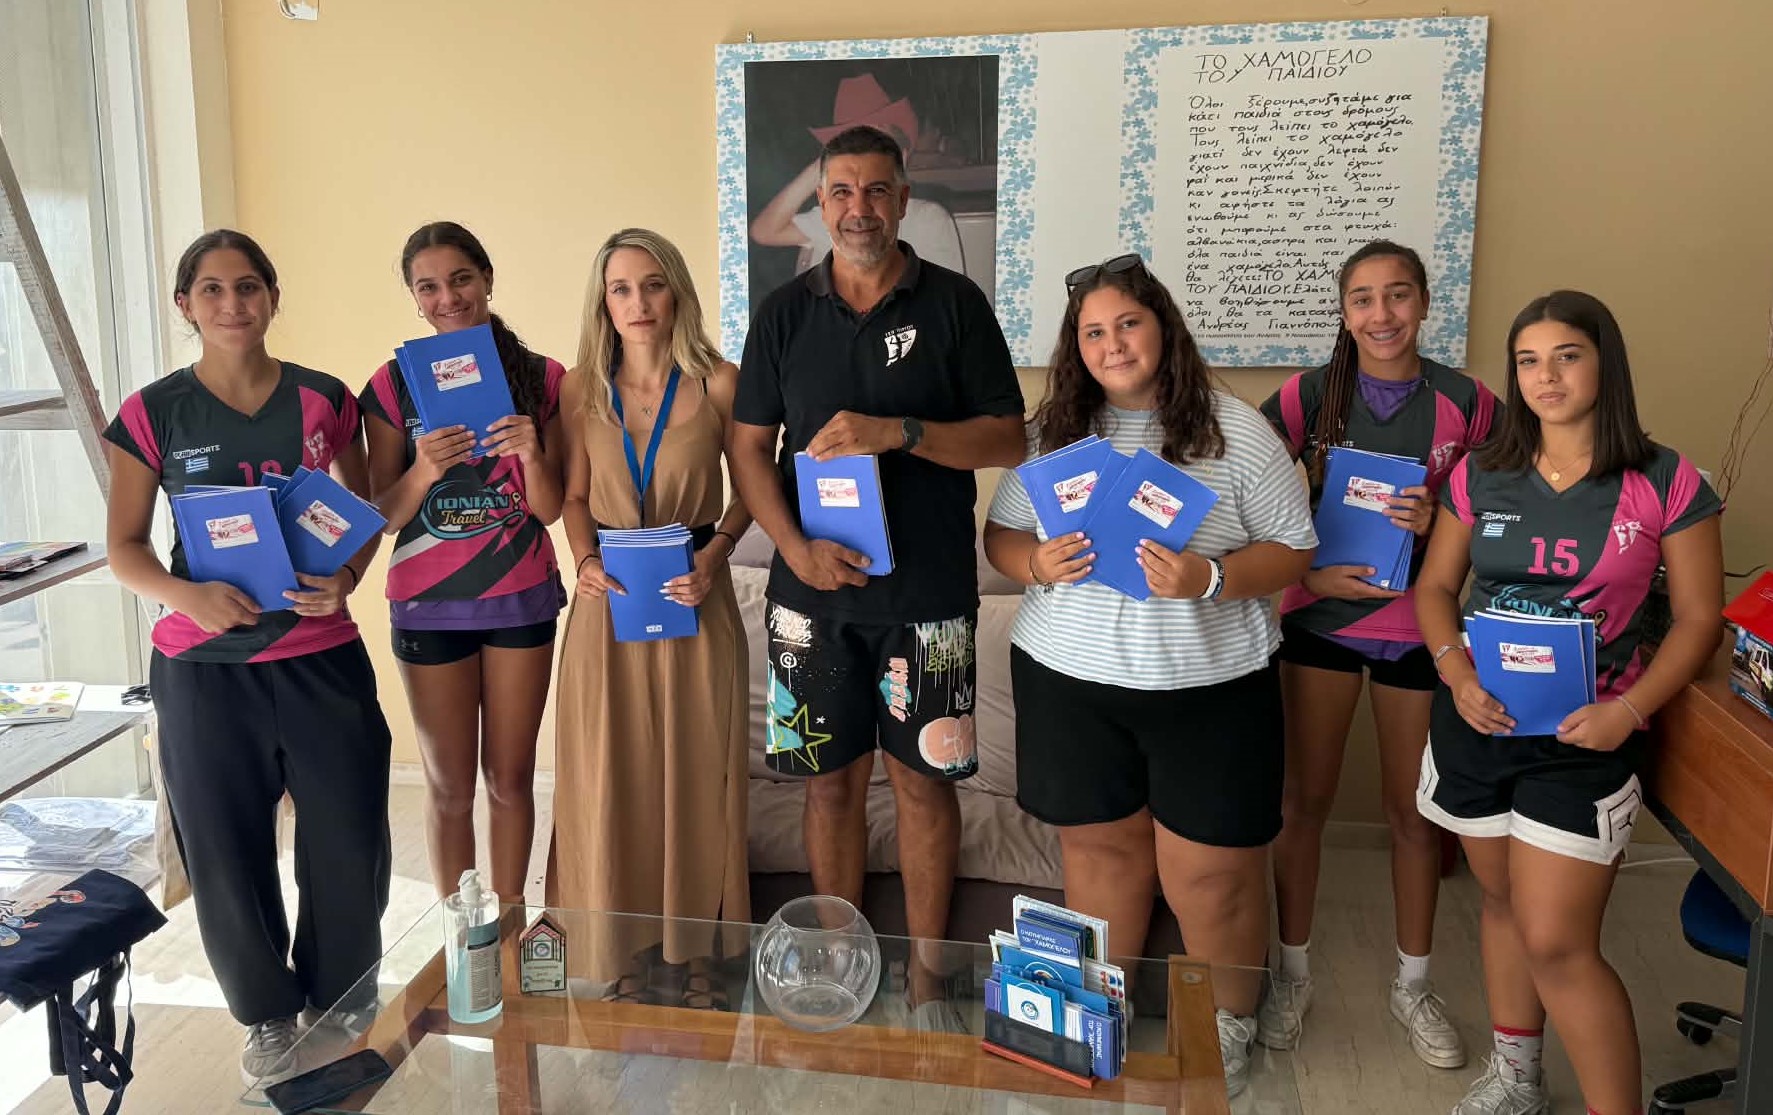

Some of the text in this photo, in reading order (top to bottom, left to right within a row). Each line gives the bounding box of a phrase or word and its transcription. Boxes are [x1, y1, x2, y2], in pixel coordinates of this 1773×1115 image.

[1195, 49, 1372, 69] ΤΟ ΧΑΜΟΓΕΛΟ
[1192, 65, 1347, 84] ΤΟΥ ΠΑΙΔΙΟΥ
[1385, 94, 1412, 103] για
[1234, 107, 1281, 119] παιδιά
[1294, 109, 1333, 118] στους
[1342, 104, 1399, 118] δρόμους
[1270, 120, 1310, 131] λείπει
[1320, 121, 1338, 129] το
[1190, 132, 1219, 147] Τους
[1237, 132, 1272, 144] λείπει
[1319, 128, 1403, 144] χαμόγελο
[1242, 147, 1261, 156] δεν
[1273, 146, 1309, 160] έχουν
[1378, 142, 1398, 153] δεν
[1190, 161, 1229, 174] έχουν
[1347, 157, 1383, 170] έχουν
[1307, 170, 1328, 180] δεν
[1344, 168, 1381, 181] έχουν
[1377, 197, 1395, 209] ας
[1186, 271, 1201, 282] θα
[1187, 284, 1218, 294] ΤΟΥ
[1226, 307, 1243, 317] θα
[437, 495, 509, 509] IONIAN
[441, 509, 487, 525] Travel
[1528, 537, 1580, 577] 15
